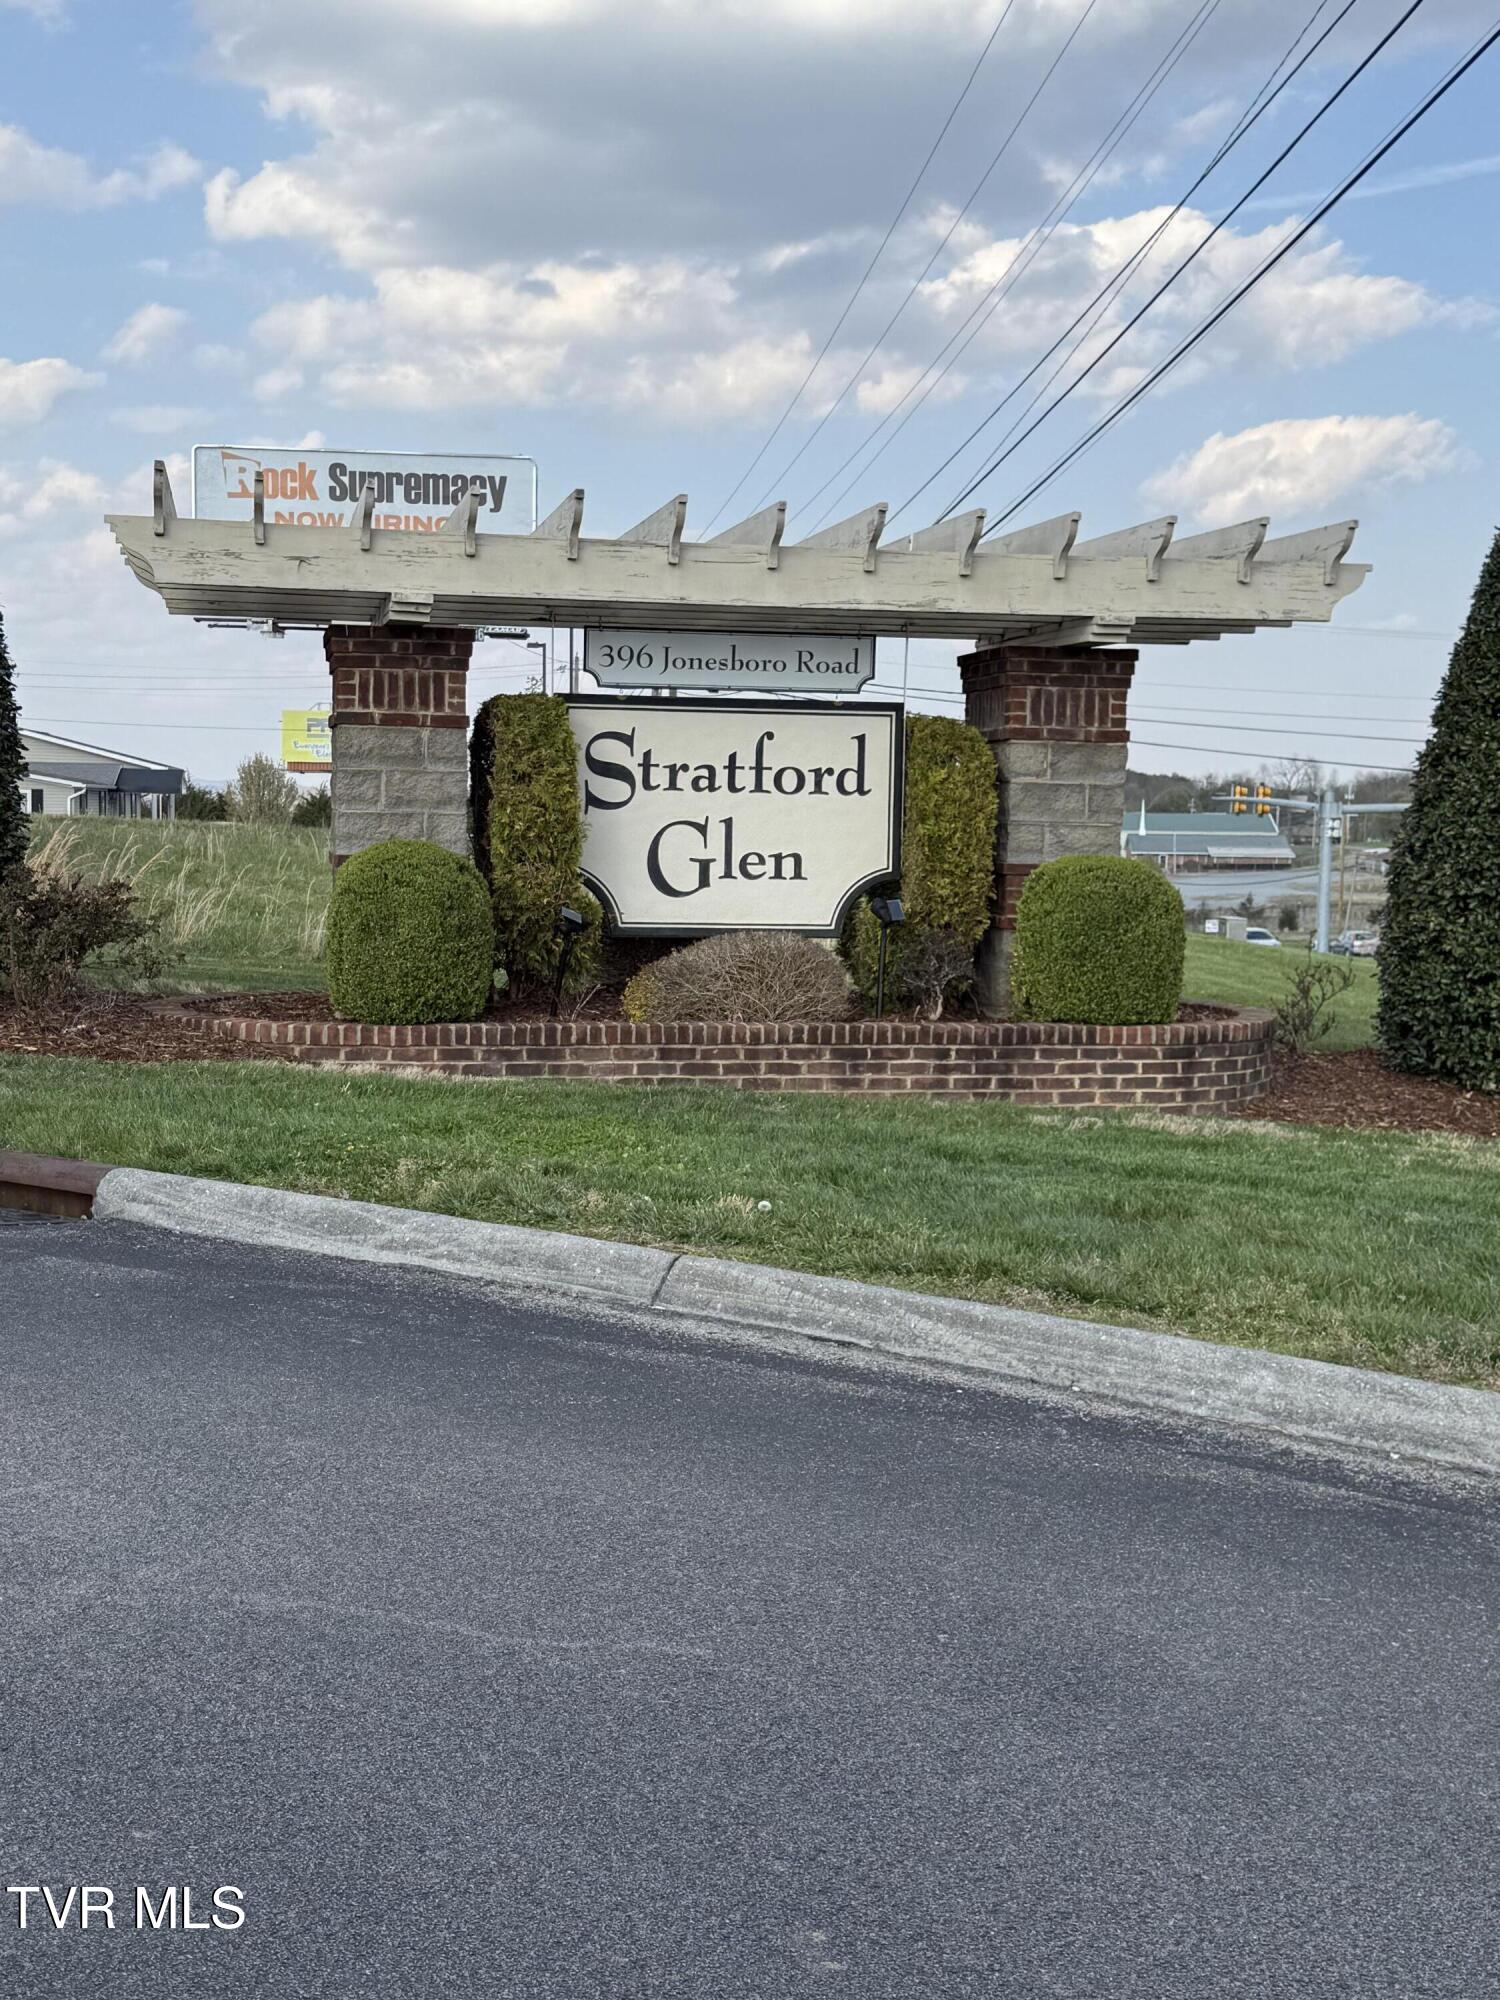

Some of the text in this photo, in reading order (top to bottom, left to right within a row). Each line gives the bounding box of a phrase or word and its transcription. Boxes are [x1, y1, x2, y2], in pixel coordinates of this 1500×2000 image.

[222, 451, 507, 512] Rock Supremacy
[274, 511, 345, 528] NOW
[598, 643, 861, 676] 396 Jonesboro Road
[584, 726, 872, 815] Stratford
[647, 815, 808, 898] Glen
